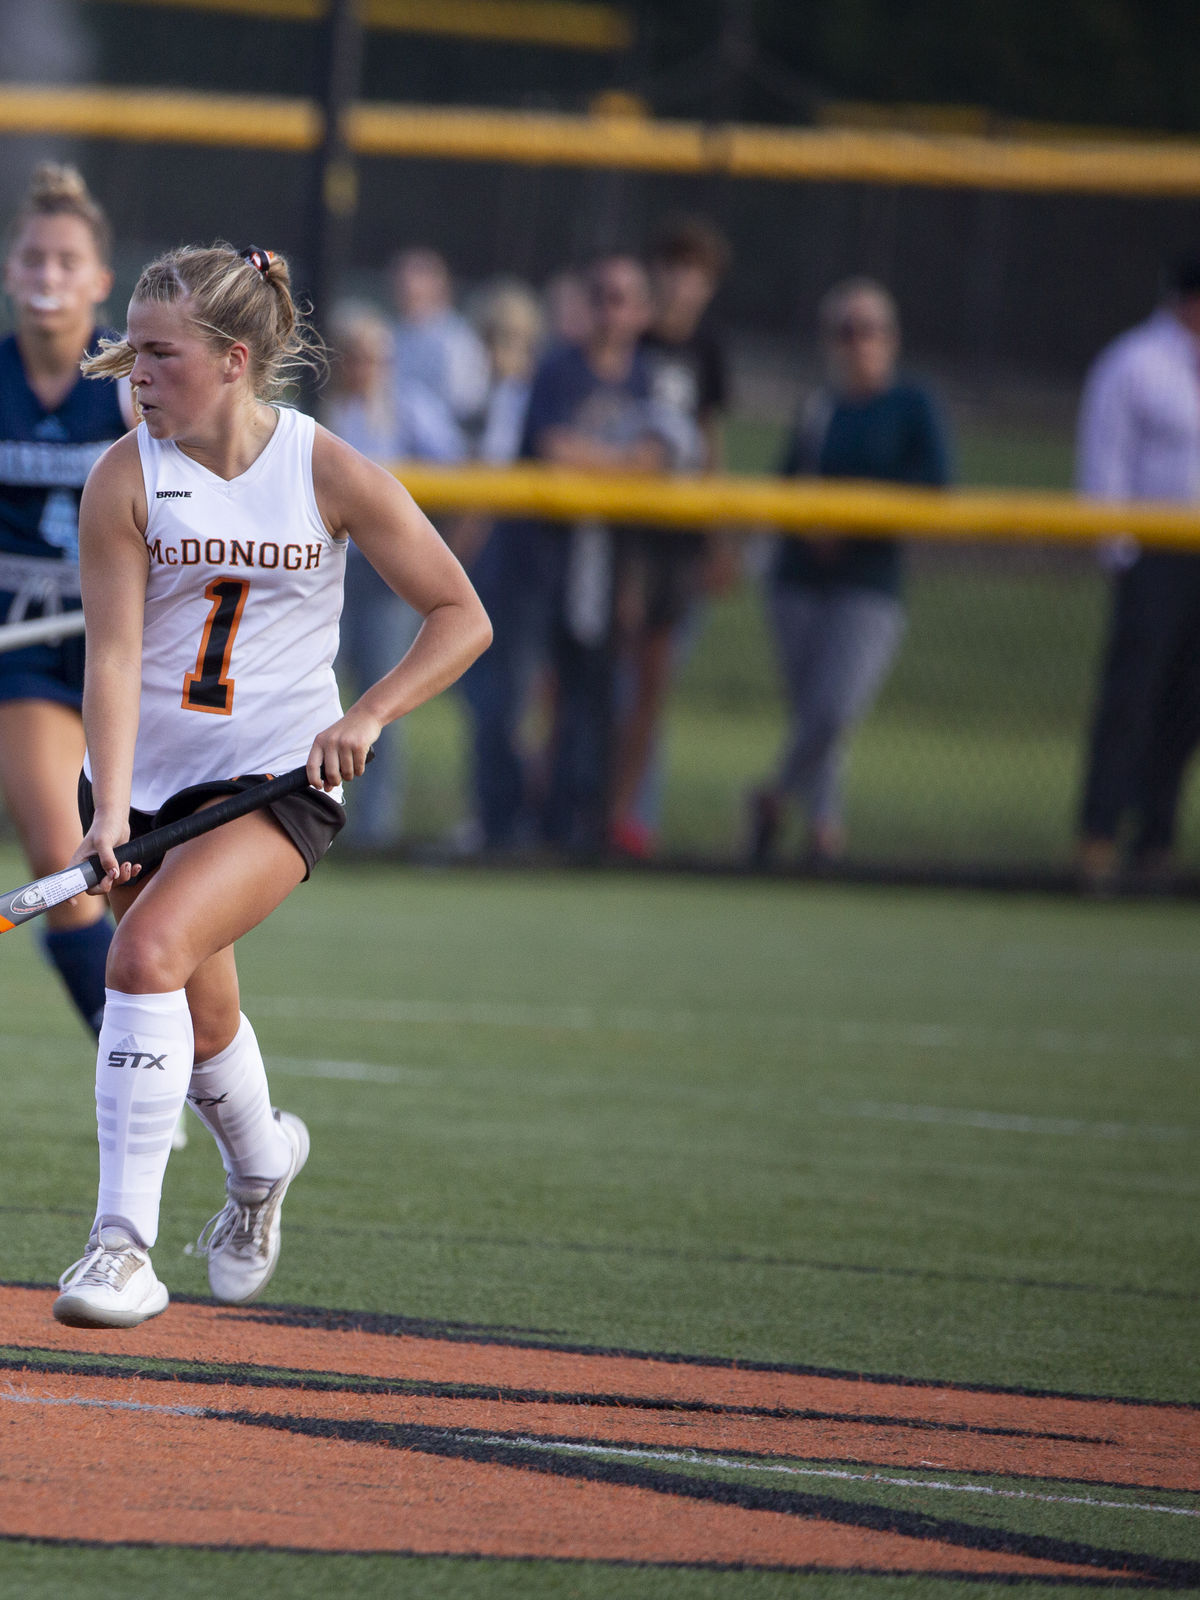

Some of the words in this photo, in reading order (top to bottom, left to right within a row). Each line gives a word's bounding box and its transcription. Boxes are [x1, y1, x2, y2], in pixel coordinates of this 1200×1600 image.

[147, 538, 322, 570] McDONOGH
[181, 576, 250, 716] 1
[107, 1051, 168, 1070] STX
